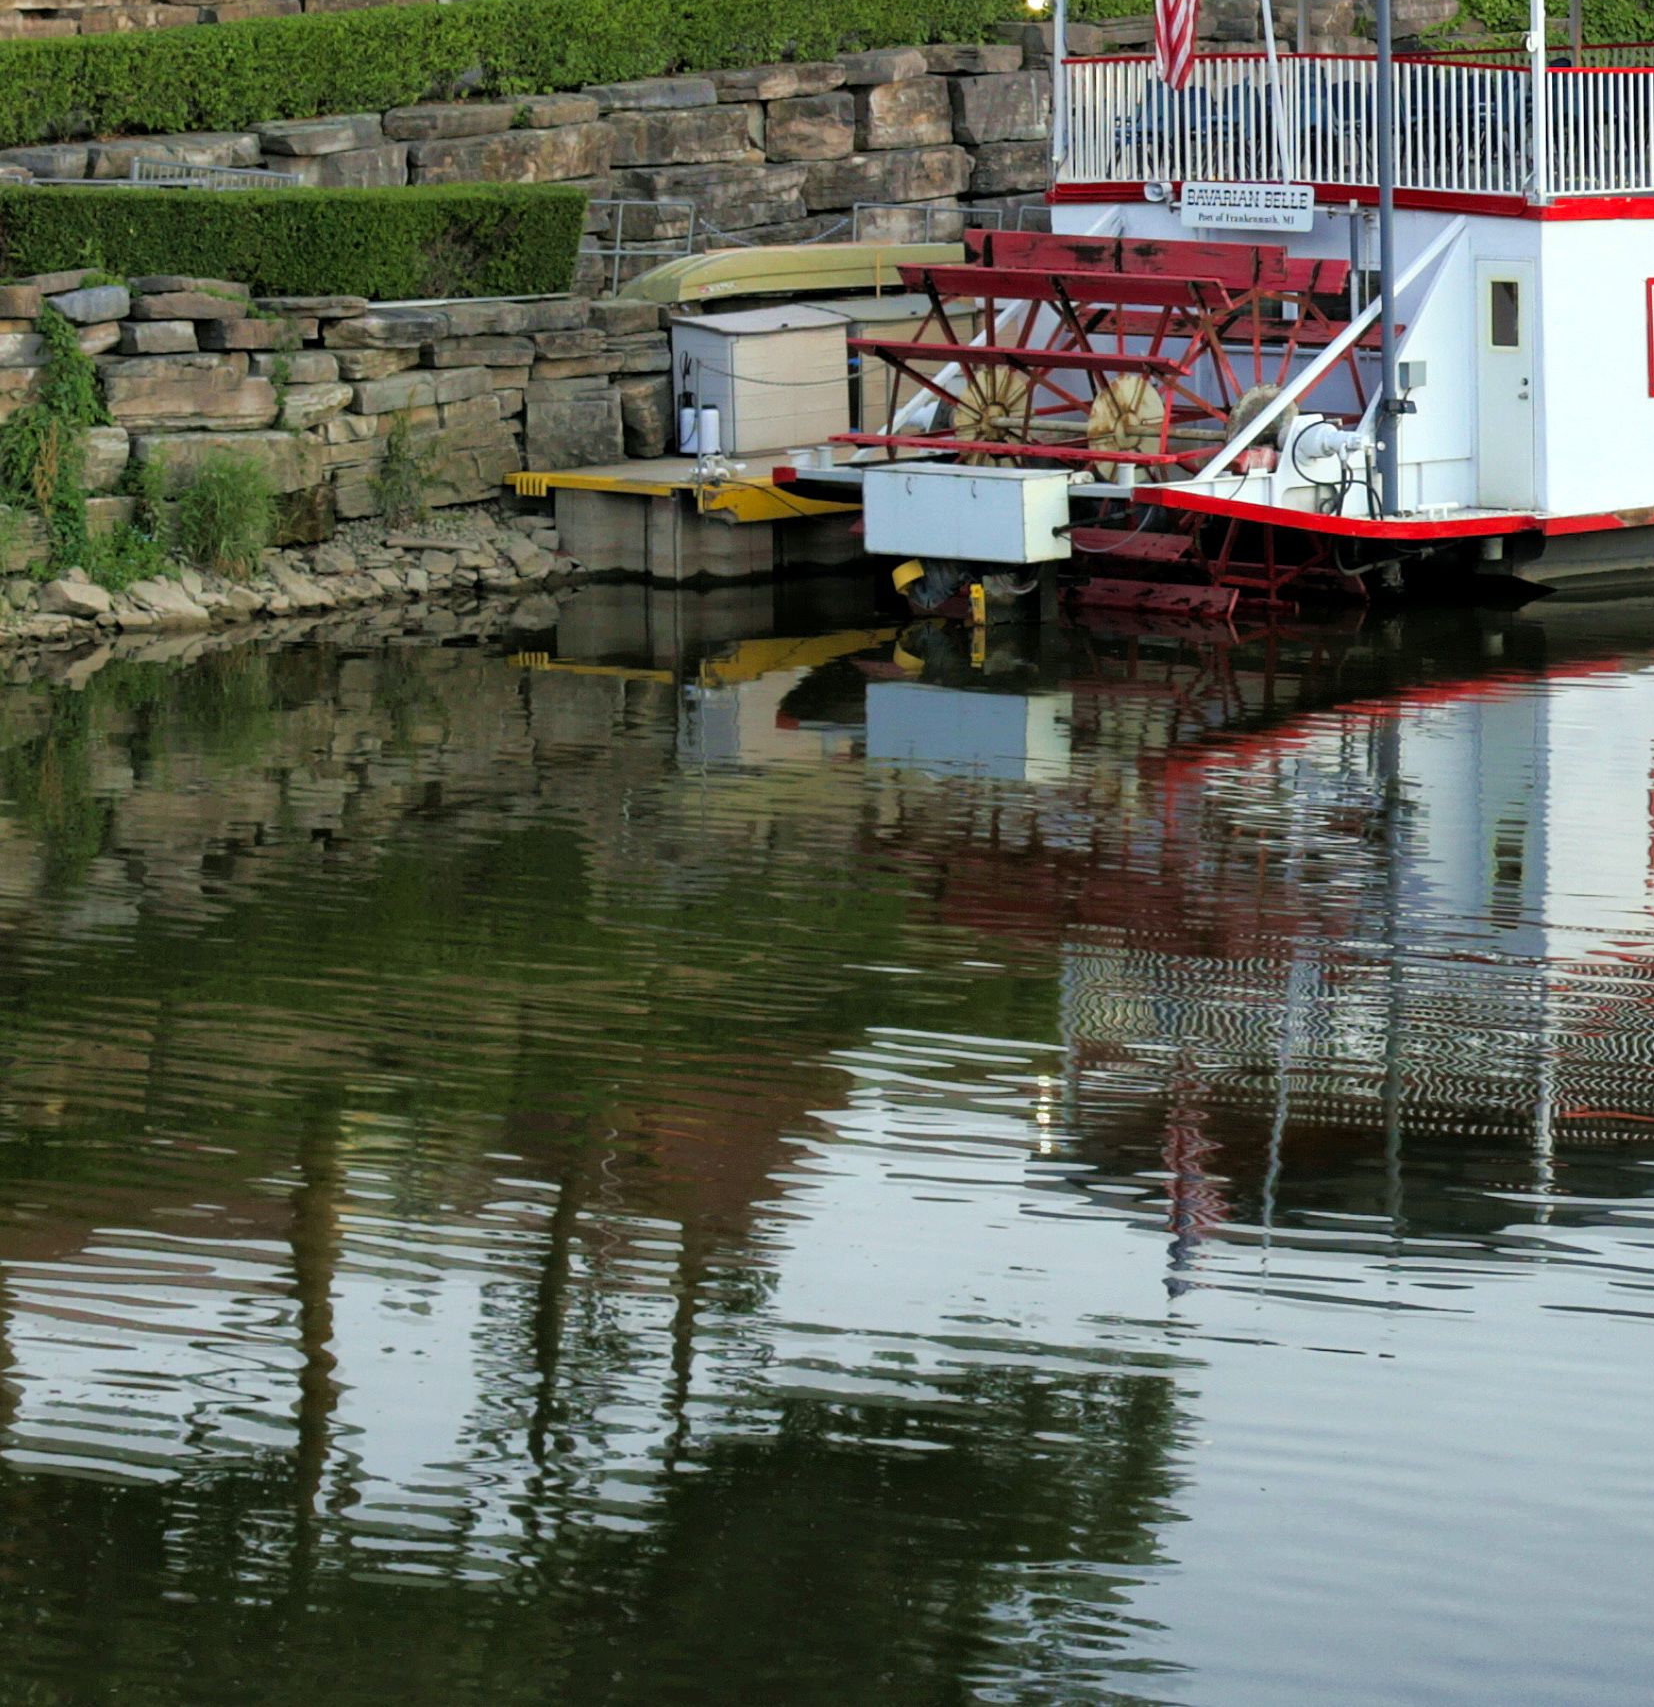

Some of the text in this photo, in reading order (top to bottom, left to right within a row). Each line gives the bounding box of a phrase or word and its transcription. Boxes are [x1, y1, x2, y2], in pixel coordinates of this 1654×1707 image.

[1187, 189, 1308, 210] BAVARIAN BELLE
[1198, 213, 1213, 221] Port
[1215, 213, 1224, 222] of
[1283, 215, 1295, 225] MI
